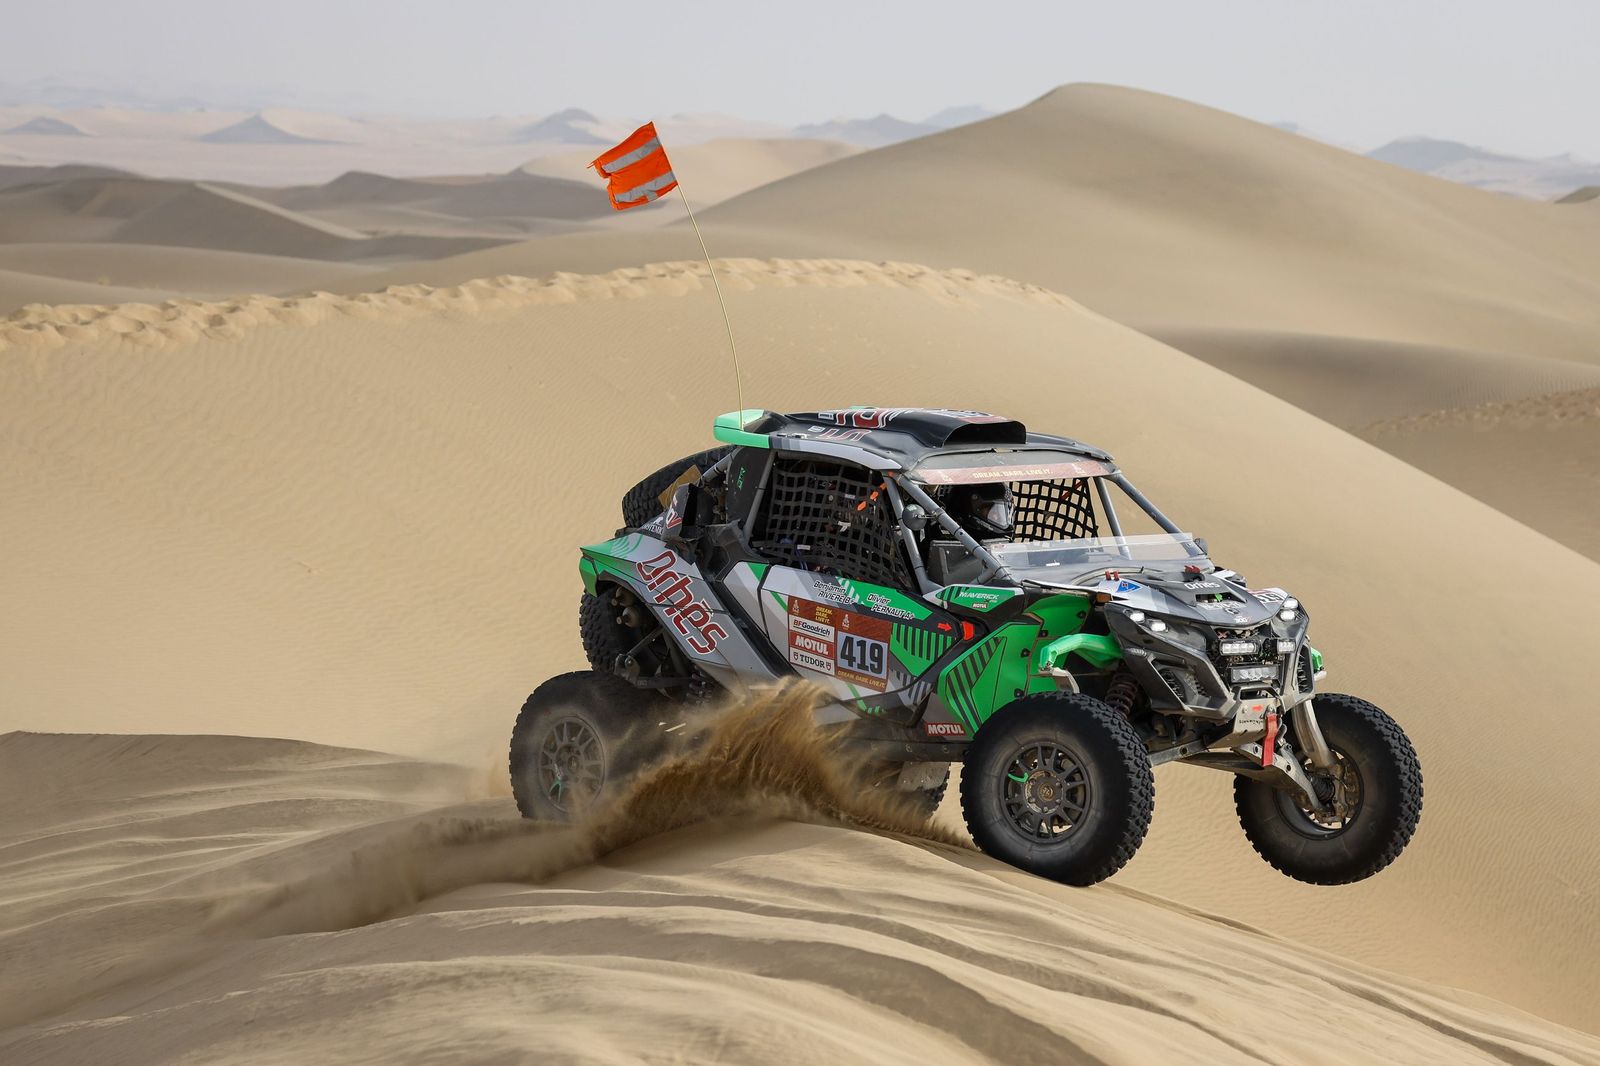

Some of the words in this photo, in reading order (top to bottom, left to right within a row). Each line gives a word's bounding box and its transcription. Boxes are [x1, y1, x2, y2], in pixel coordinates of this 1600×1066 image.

[812, 580, 847, 594] Benjamin
[867, 593, 892, 604] Olivier
[959, 591, 1000, 600] MAVERICK
[871, 603, 905, 617] PERNAUT
[793, 619, 831, 636] BFGoodrich
[795, 635, 829, 655] MOTUL
[800, 654, 826, 668] TUDOR
[840, 635, 884, 675] 419
[927, 724, 965, 735] MOTUL
